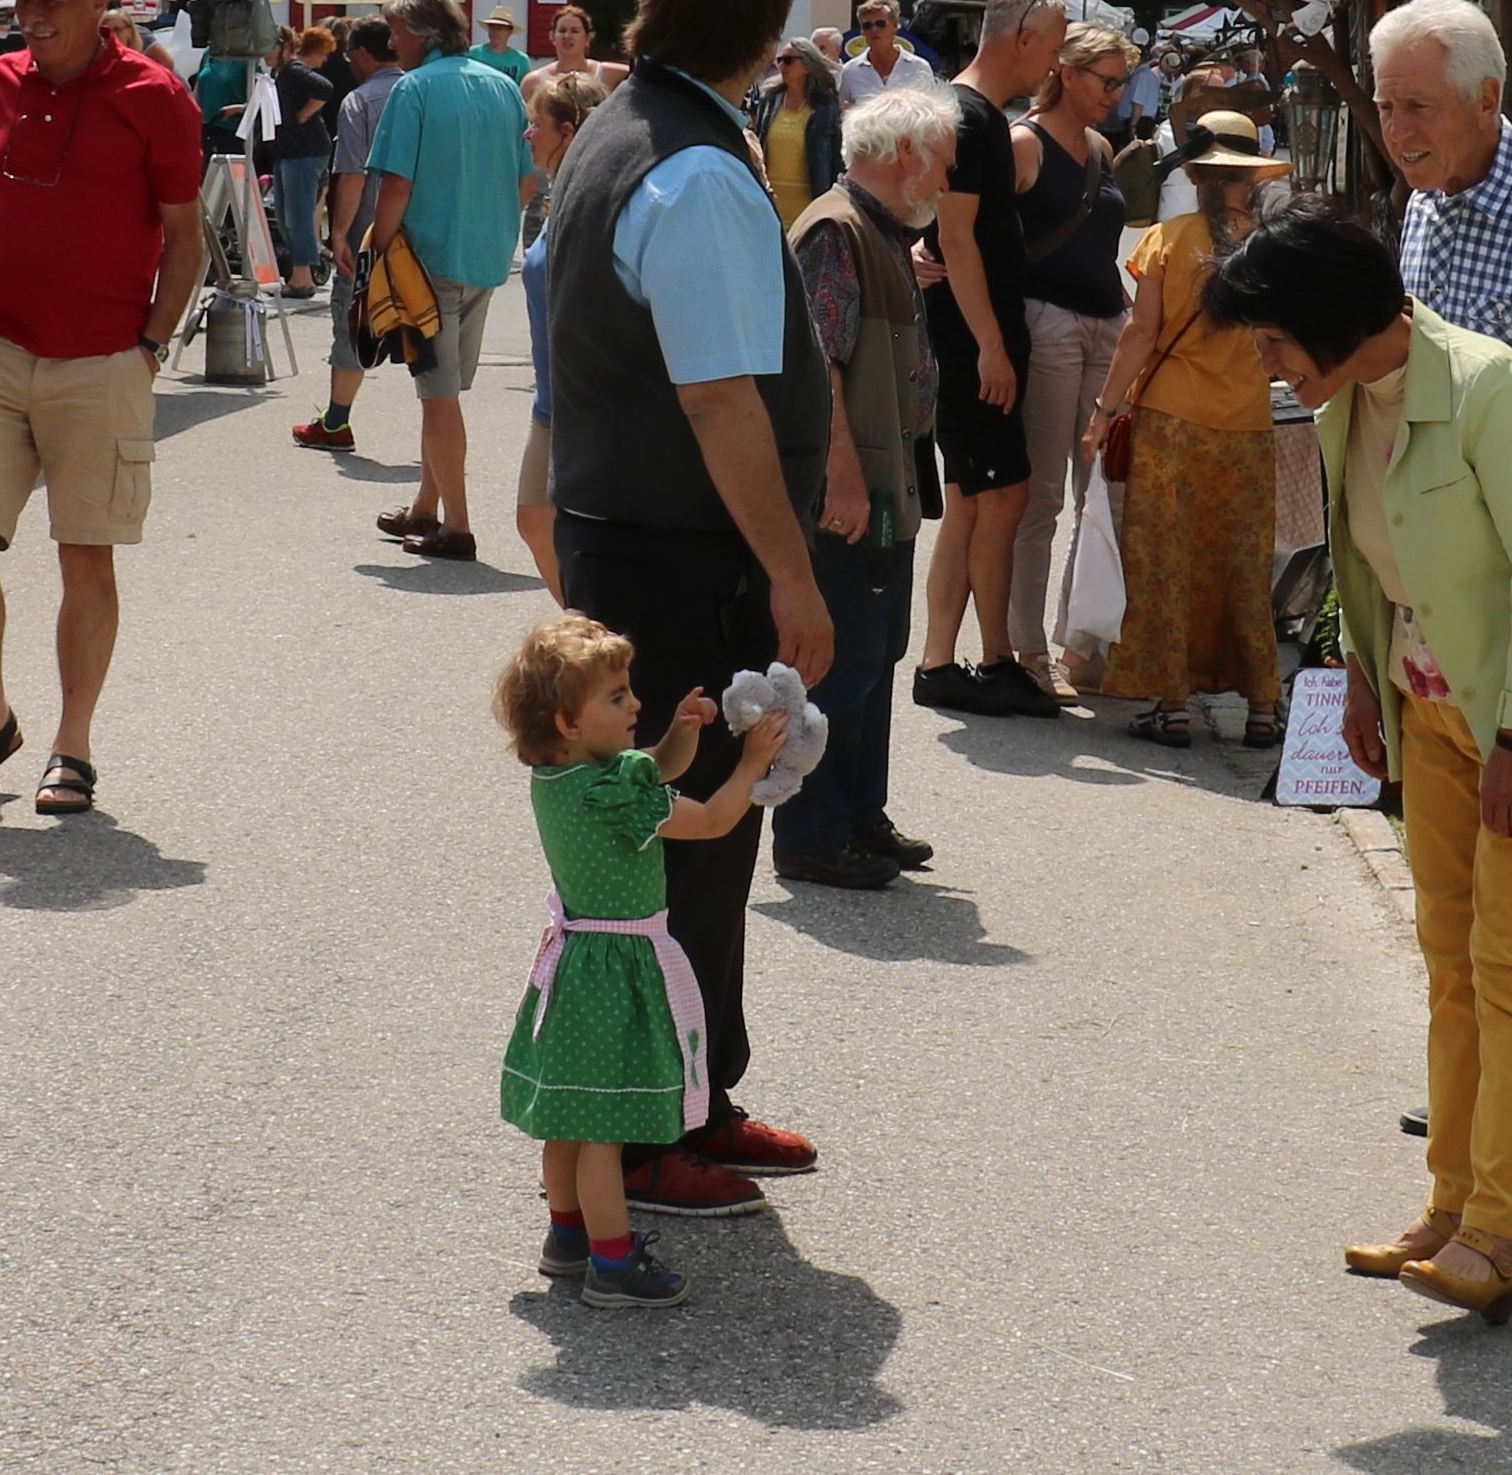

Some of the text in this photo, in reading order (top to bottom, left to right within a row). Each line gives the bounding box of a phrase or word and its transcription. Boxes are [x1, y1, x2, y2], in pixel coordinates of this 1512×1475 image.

[1304, 676, 1342, 688] Ich habe
[1306, 692, 1346, 707] TINNI
[1320, 765, 1343, 775] nur
[1294, 780, 1367, 795] PFEIFEN.
